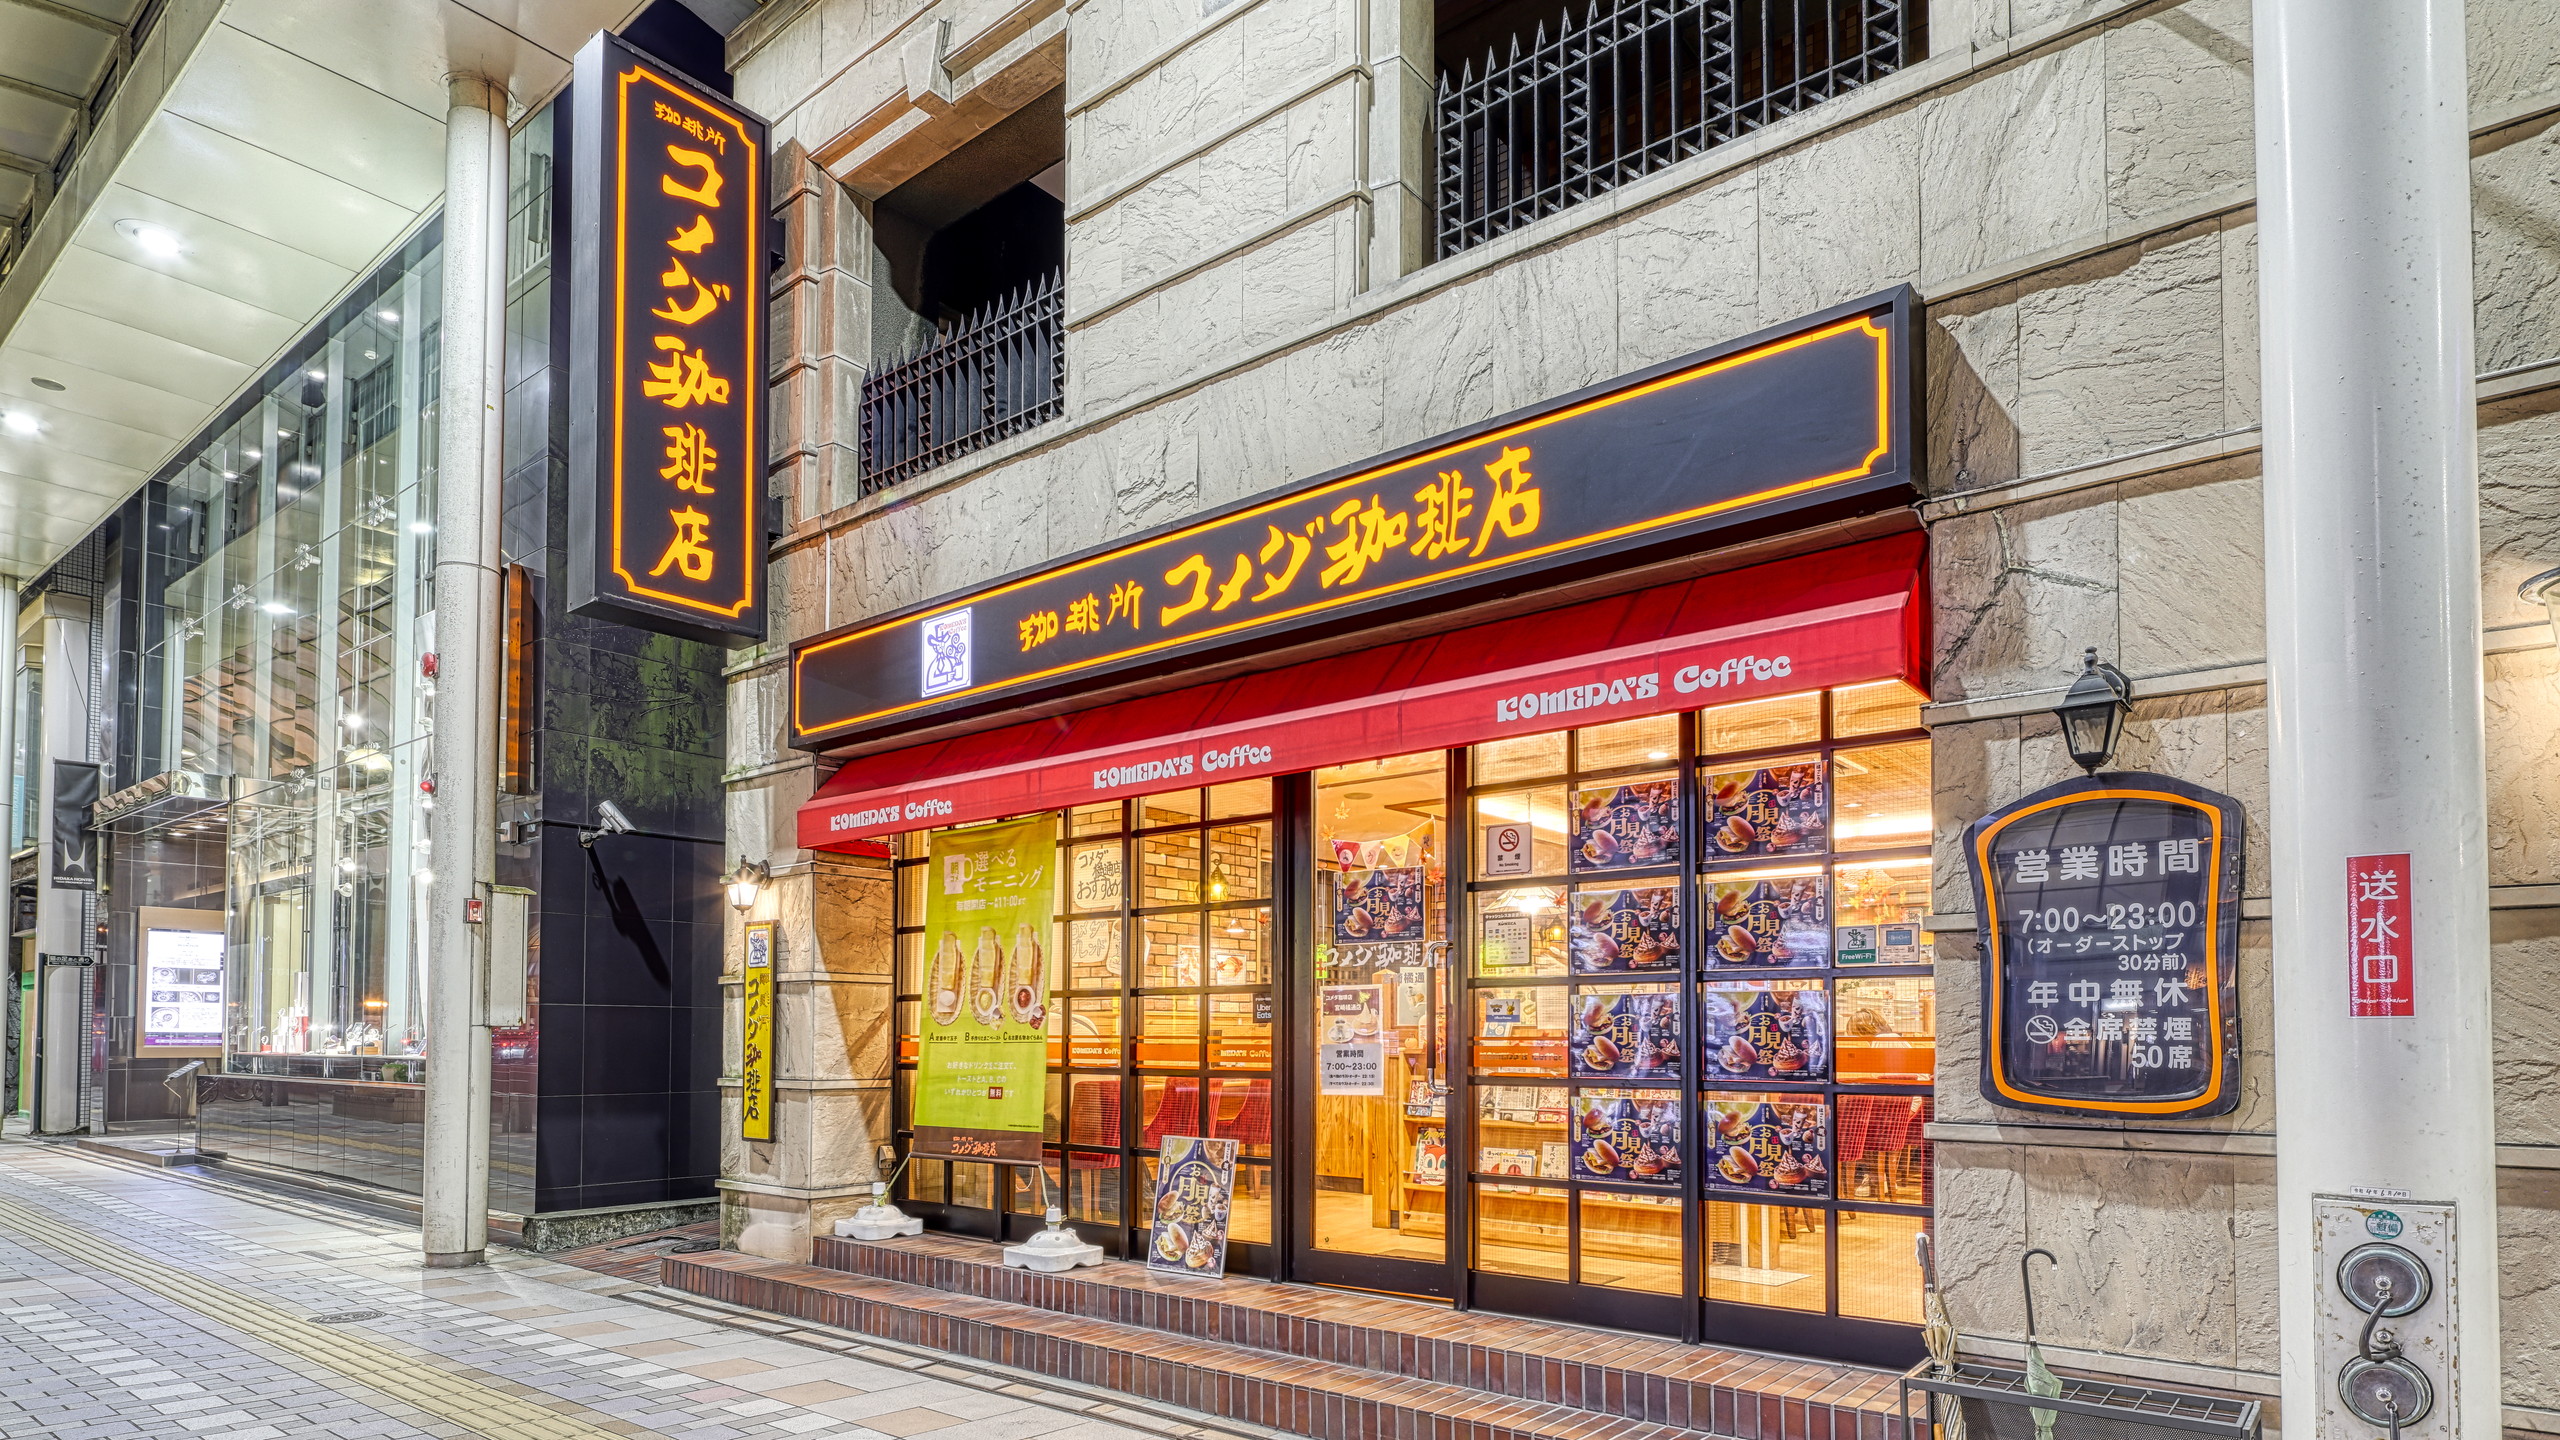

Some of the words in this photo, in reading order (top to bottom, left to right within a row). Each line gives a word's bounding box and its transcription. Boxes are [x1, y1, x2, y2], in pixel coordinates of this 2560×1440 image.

[654, 100, 727, 156] 珈琲所
[642, 144, 730, 582] コメダ珈琲店
[1160, 445, 1541, 627] コメダ珈琲店
[1018, 579, 1144, 652] 珈琲所
[1497, 672, 1659, 723] KOMEDA'S
[1673, 655, 1792, 693] Coffee
[1093, 754, 1194, 790] KOMEDA'S
[1201, 745, 1272, 772] Coffee
[830, 805, 900, 831] KOMEDA'S
[904, 798, 953, 820] Coffee
[974, 848, 1017, 873] 選べる
[1078, 849, 1109, 869] コメダ
[2014, 838, 2200, 883] 営業時間
[973, 864, 1044, 893] モーニング
[2018, 901, 2196, 934] 7:00〜23:00
[2359, 869, 2400, 983] 送水口
[2027, 932, 2185, 955] (オーダーストップ
[2118, 953, 2188, 971] 30分前)
[2027, 977, 2189, 1008] 年中無休
[1256, 1003, 1271, 1012] Uber
[1256, 1011, 1272, 1019] Eats
[929, 1032, 935, 1040] A
[965, 1032, 970, 1040] B
[1003, 1032, 1008, 1040] C
[2063, 1016, 2192, 1041] 全席禁煙
[744, 977, 762, 1122] コメダ珈琲店
[1335, 1049, 1364, 1058] 営業時間
[2132, 1045, 2192, 1069] 50席
[1326, 1062, 1377, 1070] 7:00〜23:00
